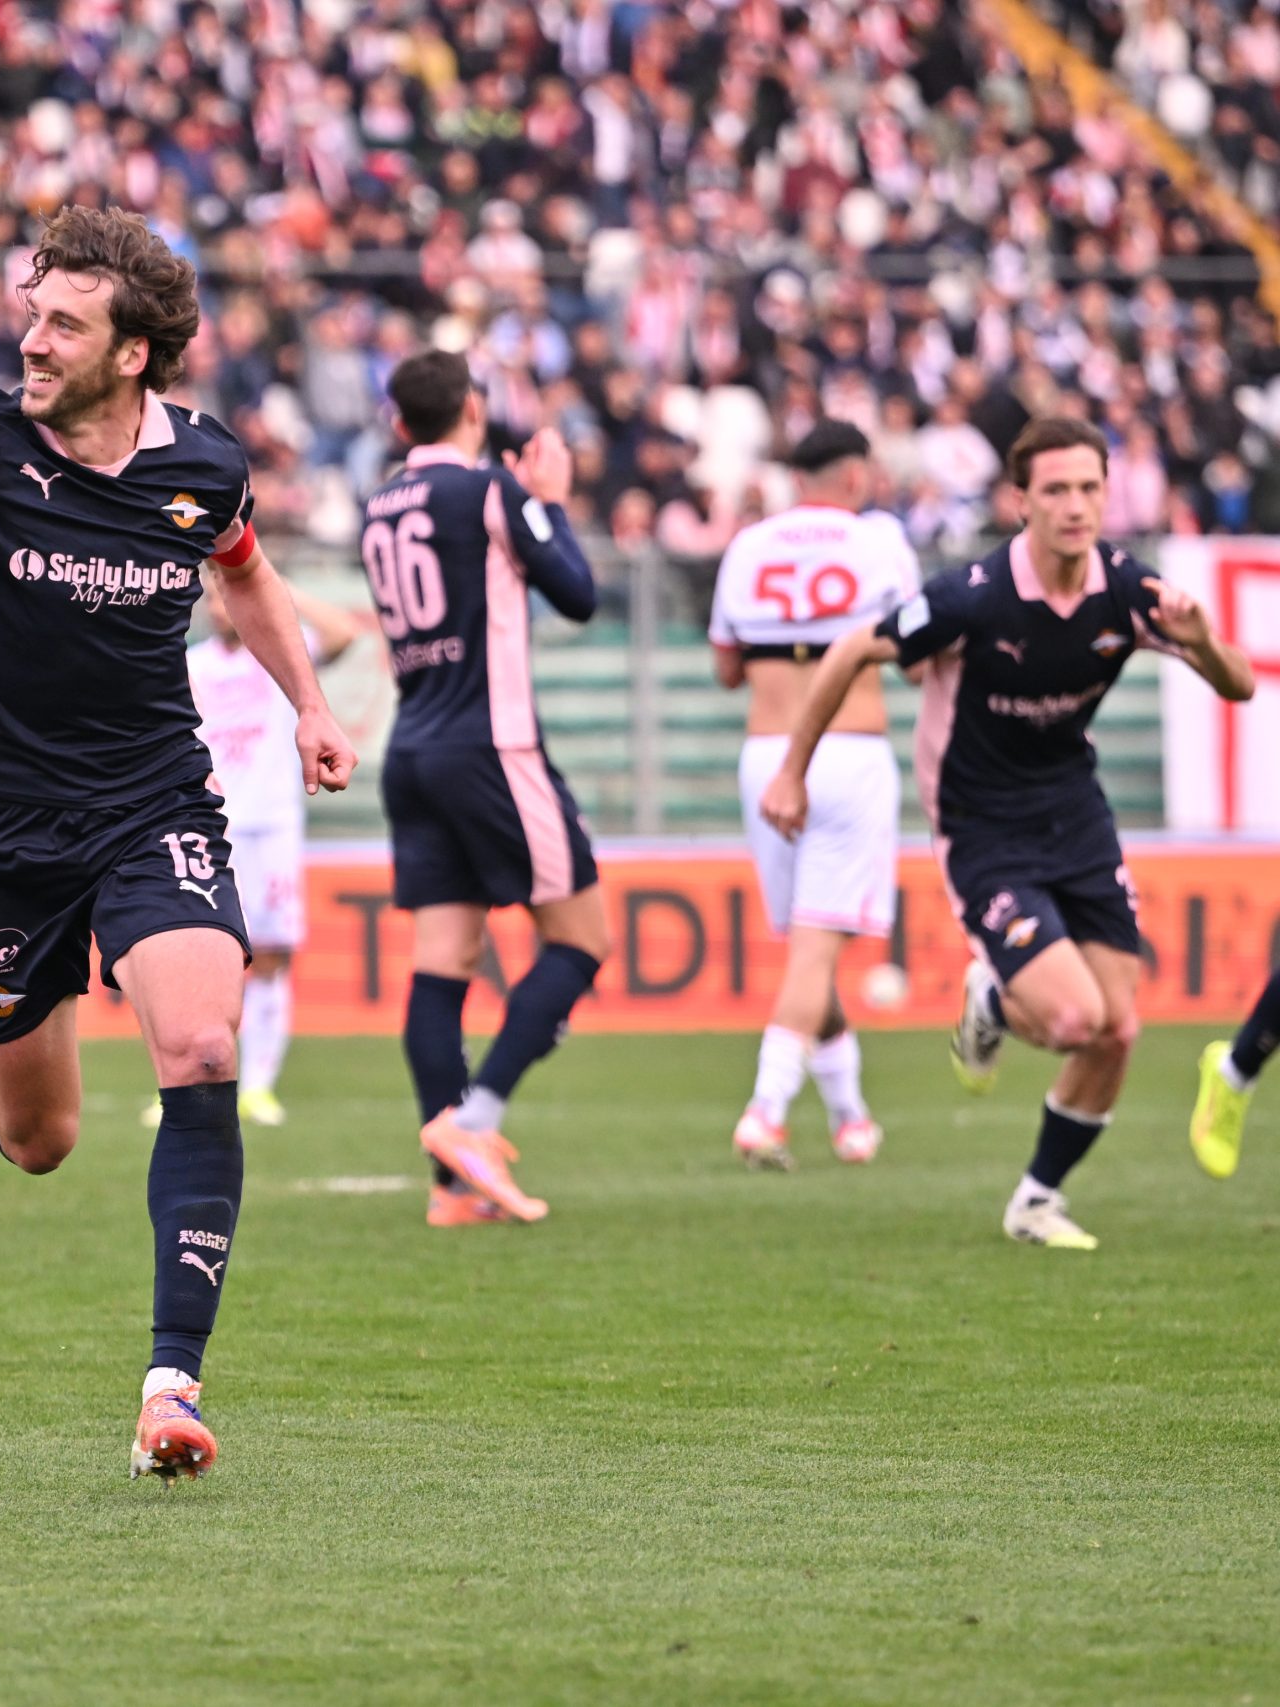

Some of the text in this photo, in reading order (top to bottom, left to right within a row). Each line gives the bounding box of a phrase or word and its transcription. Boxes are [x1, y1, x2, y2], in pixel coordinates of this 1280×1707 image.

[47, 553, 122, 593] Sicily
[160, 561, 193, 590] Car
[362, 510, 448, 639] 96
[70, 582, 149, 614] My Love
[160, 832, 215, 880] 13
[178, 1235, 227, 1252] AQUILE
[179, 1230, 229, 1245] SIAMO
